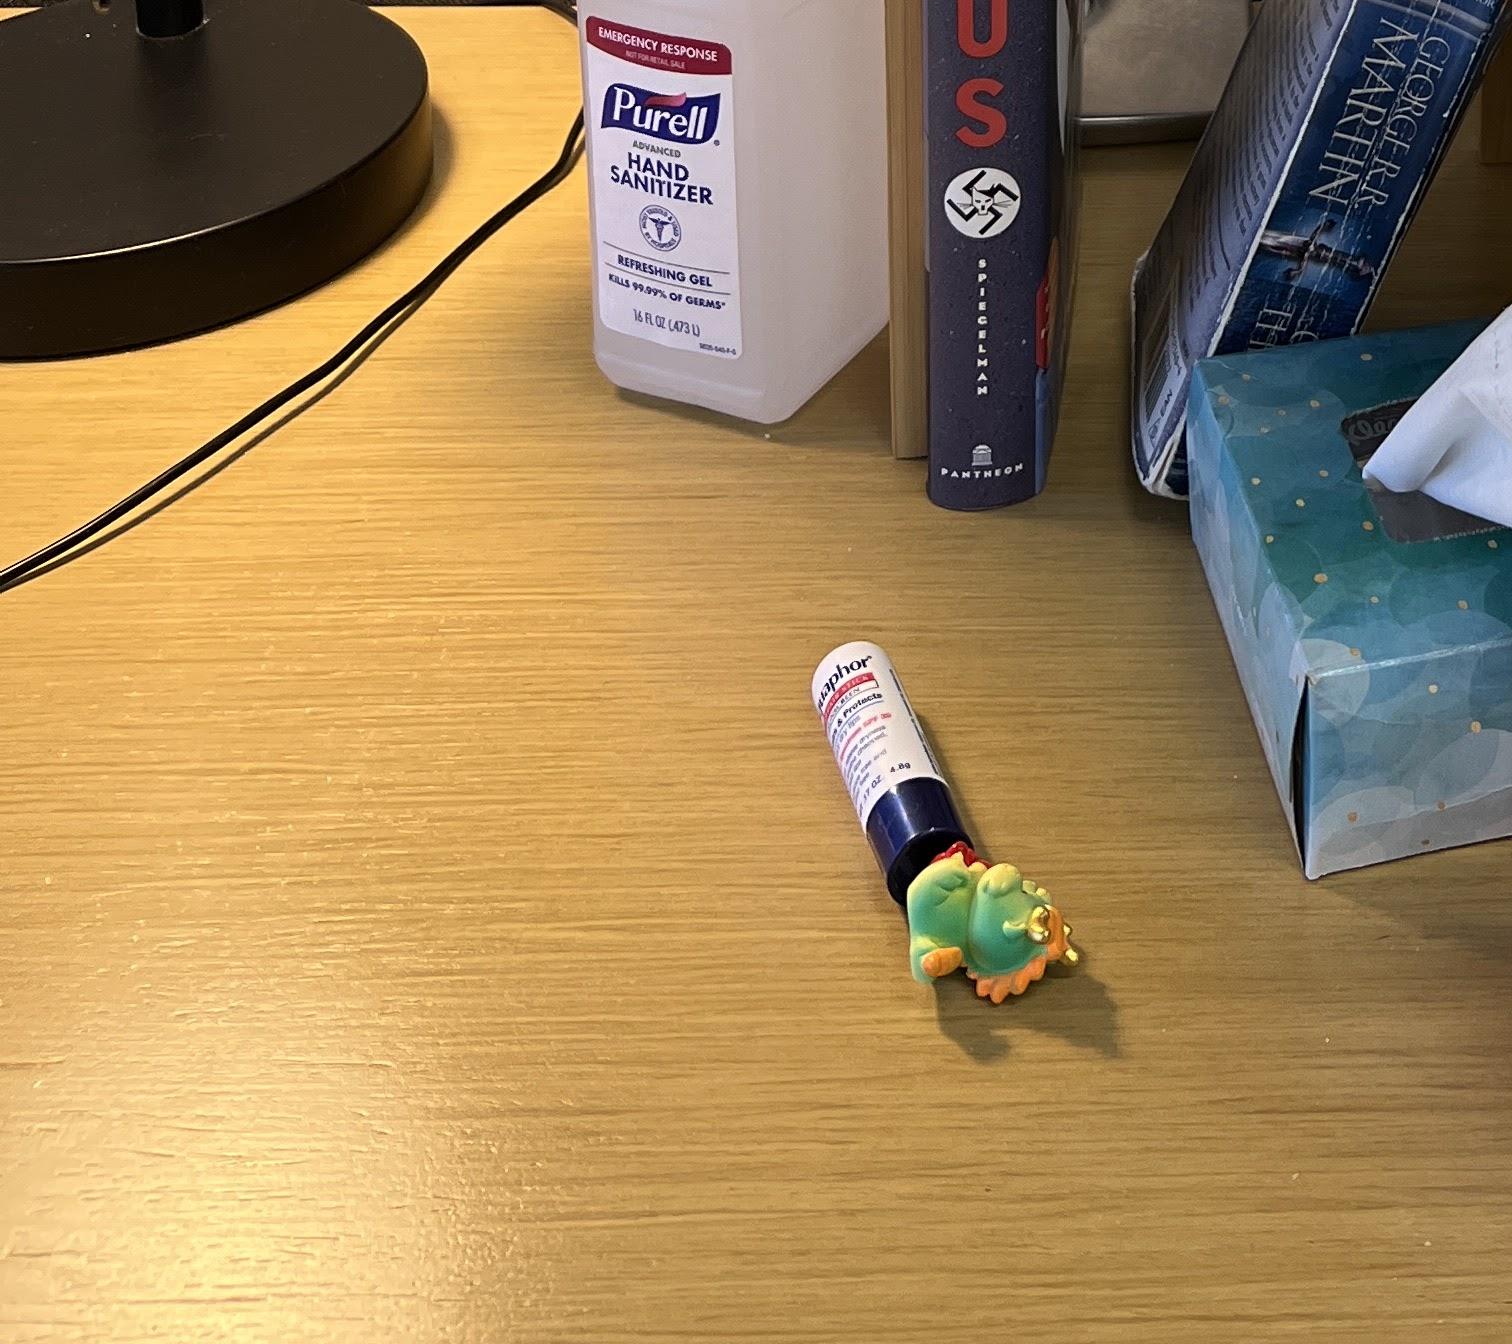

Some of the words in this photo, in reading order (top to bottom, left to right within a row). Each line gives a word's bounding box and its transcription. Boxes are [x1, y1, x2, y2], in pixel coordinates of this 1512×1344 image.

[598, 26, 659, 52] EMERGENCY
[660, 42, 718, 62] RESPONSE
[612, 86, 709, 141] Purell
[1308, 17, 1421, 207] MARTIN
[1385, 36, 1451, 158] GEORGE
[632, 140, 682, 158] ADVANCED
[628, 151, 690, 183] HAND
[610, 164, 714, 205] SANITIZER
[608, 273, 630, 288] KILLS
[632, 281, 667, 300] 99.99%
[669, 292, 683, 303] OF
[617, 254, 686, 283] REFRESHING
[689, 272, 713, 288] GEL
[633, 308, 643, 323] 16
[645, 312, 655, 326] FL
[655, 315, 666, 330] OZ
[976, 258, 989, 396] SPIEGELMAN
[940, 462, 1025, 480] PANTHEON
[842, 692, 883, 719] Protects
